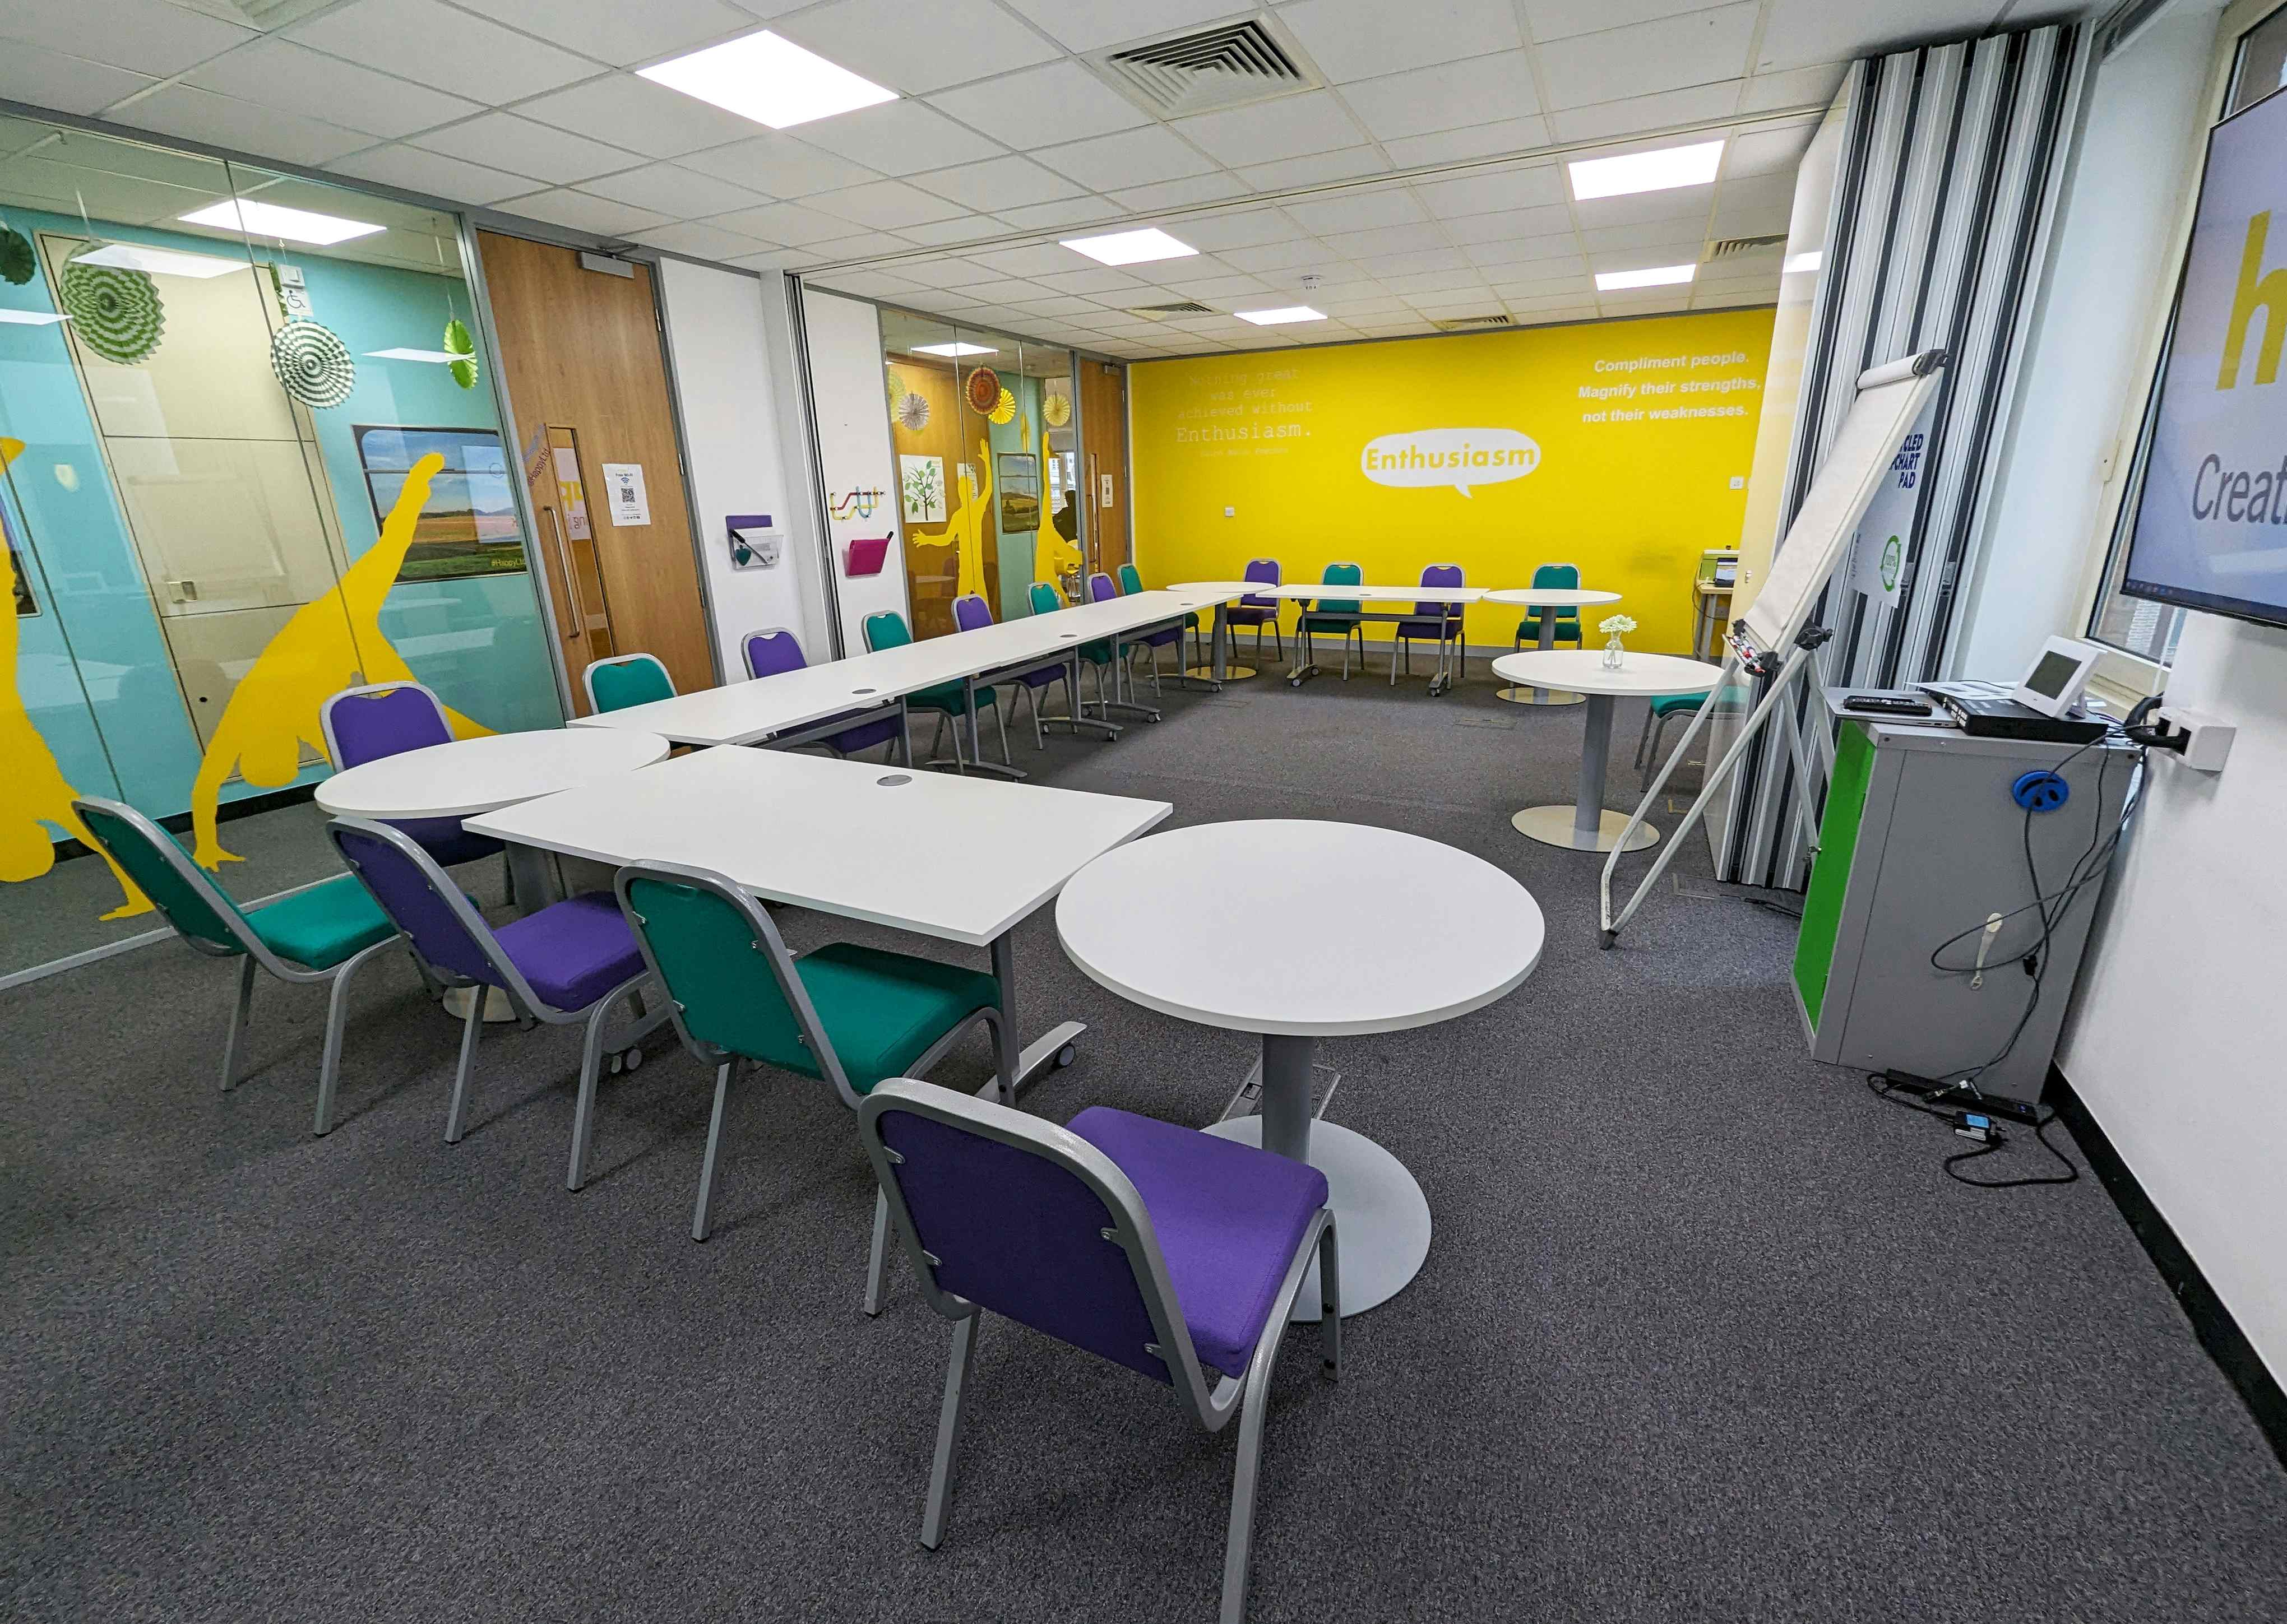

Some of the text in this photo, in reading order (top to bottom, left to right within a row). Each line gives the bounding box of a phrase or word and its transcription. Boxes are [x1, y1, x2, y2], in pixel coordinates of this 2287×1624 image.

[1594, 351, 1749, 373] Compliment people.
[1243, 388, 1276, 399] ever
[1578, 377, 1761, 400] Magnify their strengths,
[1178, 401, 1313, 419] achieved without
[1582, 406, 1749, 423] not their weaknesses.
[1176, 422, 1312, 442] Enthusiasm.
[1900, 434, 1924, 452] CLED
[1365, 442, 1535, 471] Enthusiasm
[1897, 471, 1916, 489] PAD
[2193, 454, 2287, 525] Creat
